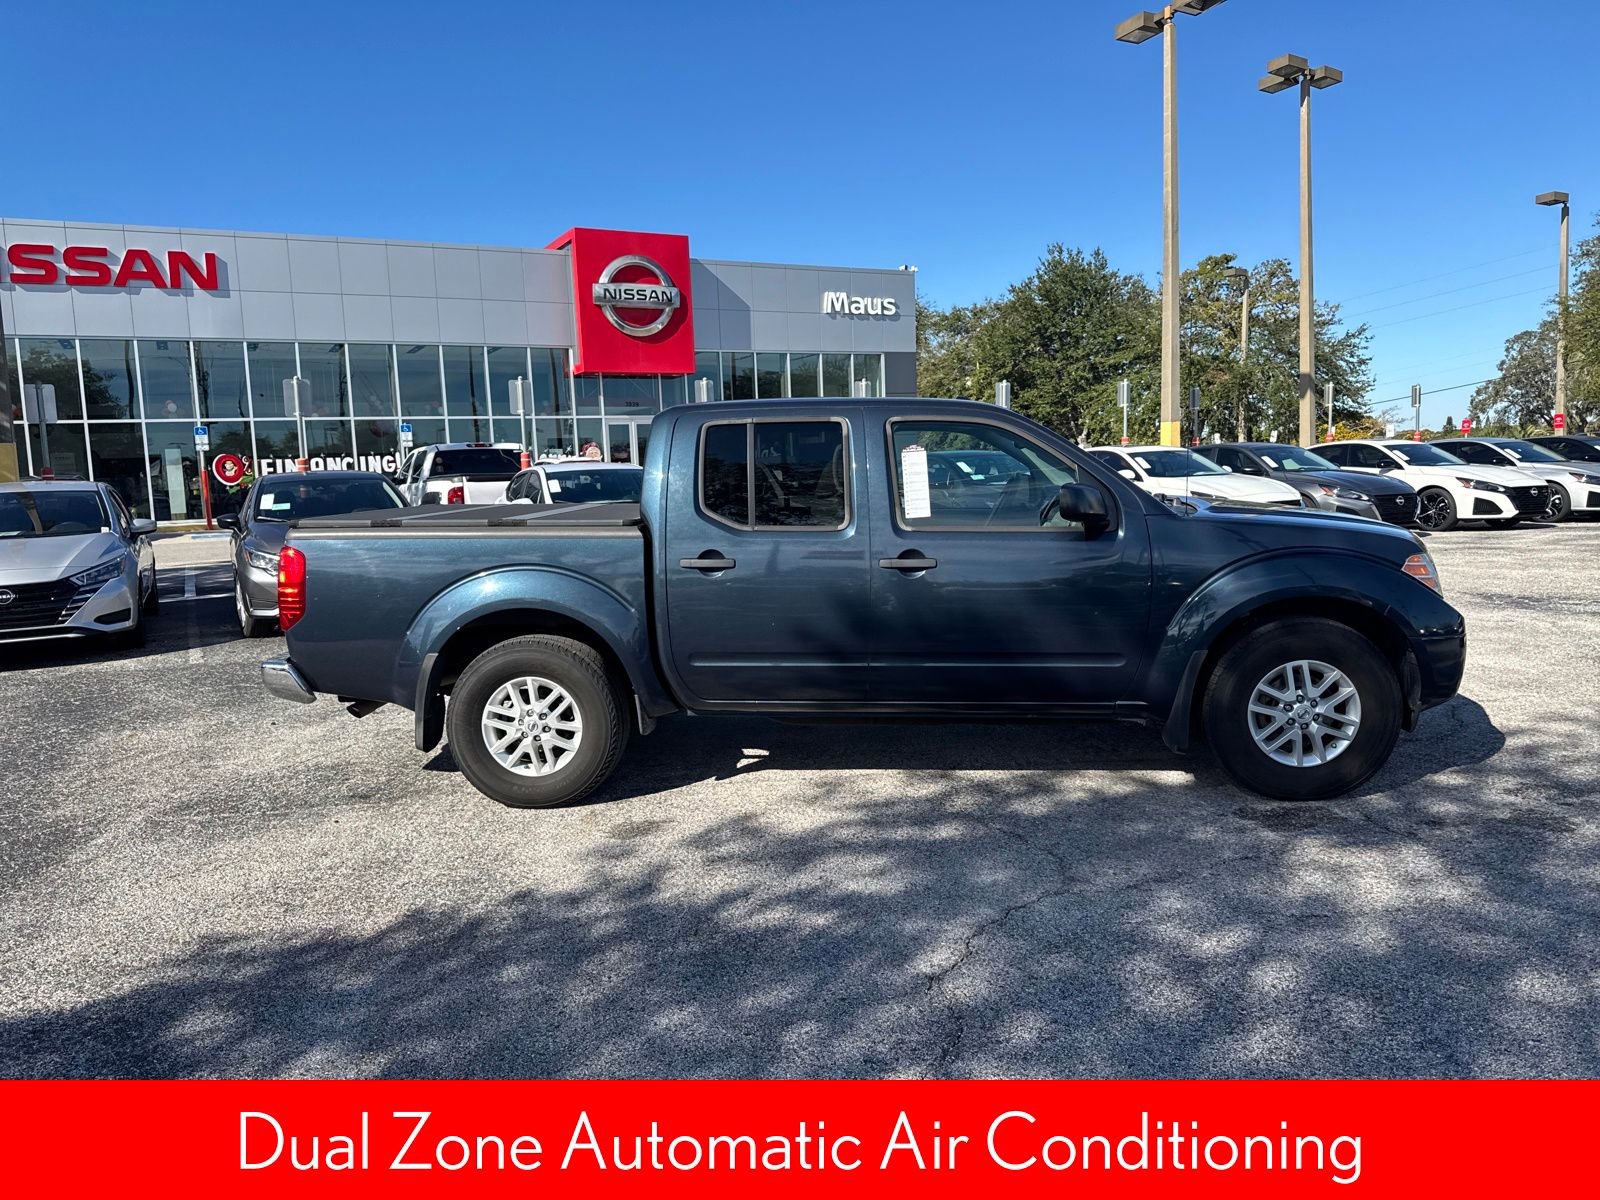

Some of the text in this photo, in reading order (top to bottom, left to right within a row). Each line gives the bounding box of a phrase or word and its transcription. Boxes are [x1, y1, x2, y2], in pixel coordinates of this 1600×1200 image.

[0, 243, 219, 290] SSAN
[603, 288, 673, 302] NISSAN
[823, 291, 896, 315] Maus
